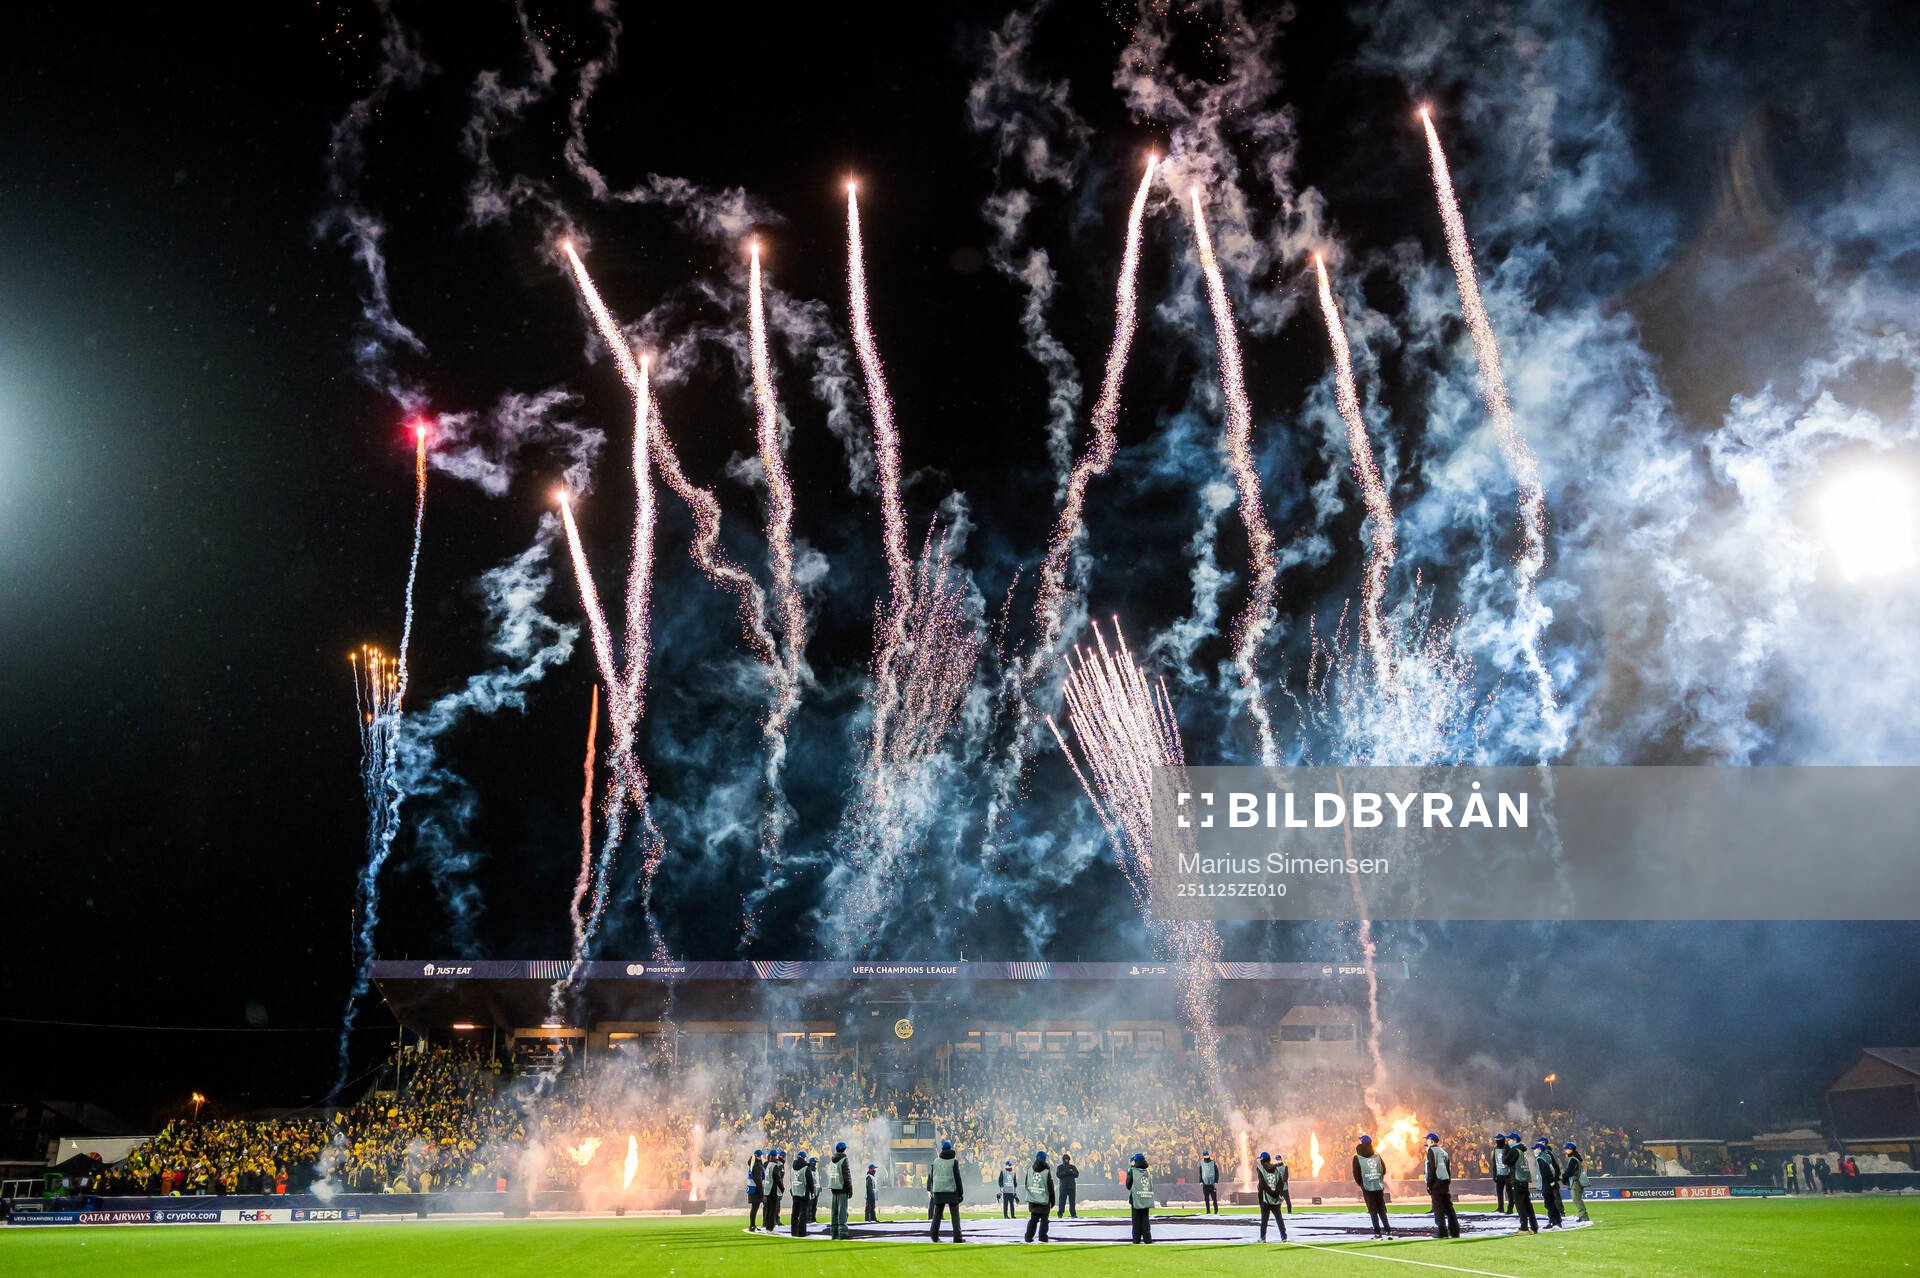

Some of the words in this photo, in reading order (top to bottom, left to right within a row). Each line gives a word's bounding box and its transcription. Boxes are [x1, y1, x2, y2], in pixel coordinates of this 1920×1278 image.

[436, 967, 455, 975] JUST
[456, 967, 472, 975] EAT
[853, 966, 874, 974] UEFA
[876, 966, 924, 974] CHAMPIONS
[926, 966, 957, 974] LEAGUE
[1141, 967, 1167, 975] PS5
[1339, 967, 1366, 975] PEPSI
[1632, 1189, 1675, 1197] mastercard
[1690, 1187, 1708, 1197] JUST
[1711, 1187, 1727, 1196] EAT
[79, 1212, 110, 1224] QATAR
[111, 1212, 151, 1222] AIRWAYS
[166, 1211, 218, 1222] crypto.com
[239, 1210, 272, 1222] FedEx
[309, 1210, 342, 1220] PEPSI
